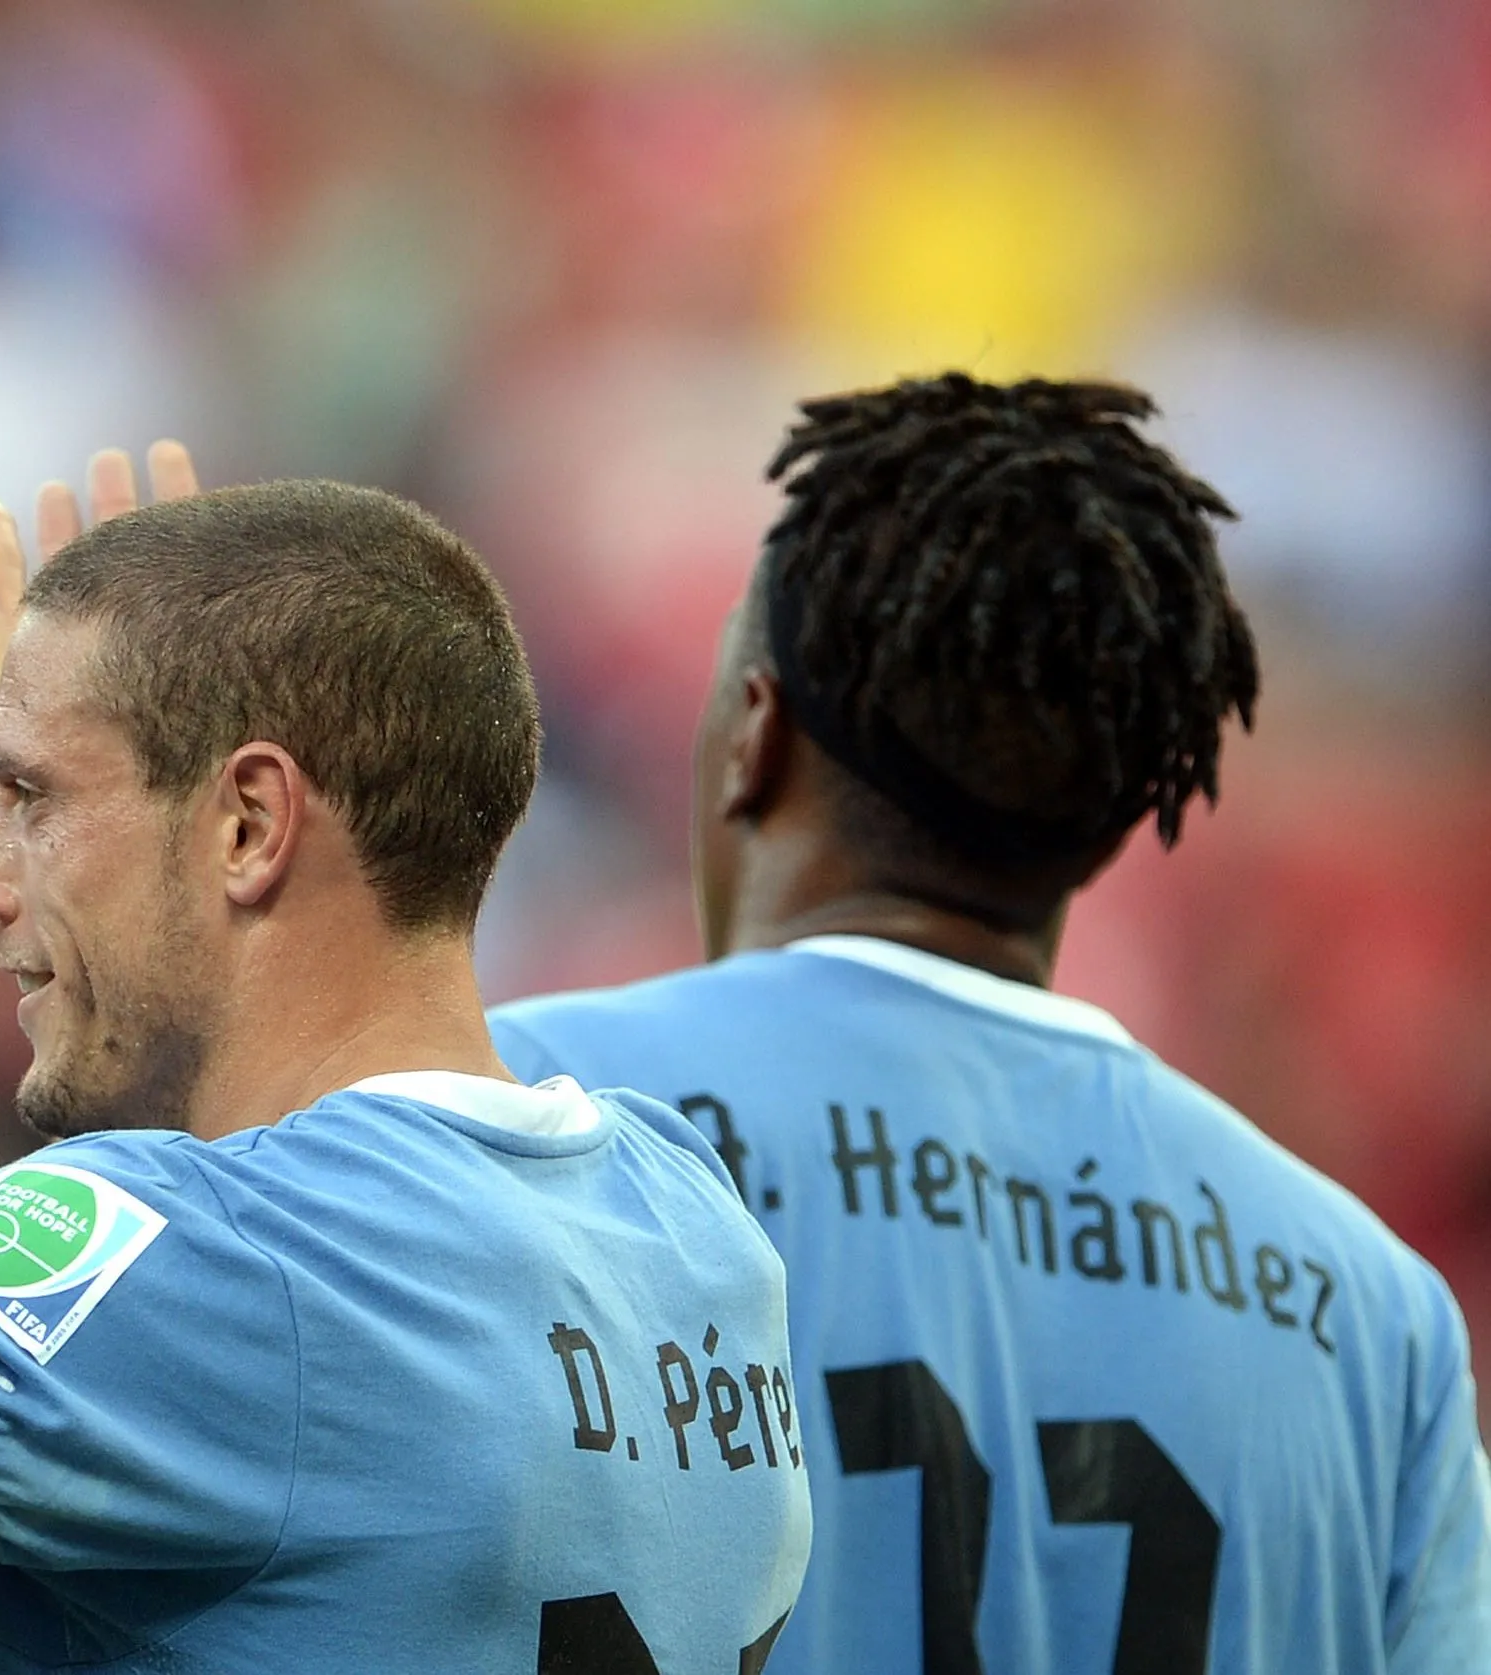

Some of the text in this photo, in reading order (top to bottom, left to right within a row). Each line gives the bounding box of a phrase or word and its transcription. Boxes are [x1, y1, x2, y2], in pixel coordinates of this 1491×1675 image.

[24, 1205, 78, 1243] HOPE
[828, 1103, 1336, 1354] Hernández
[4, 1299, 47, 1342] FIFA
[547, 1322, 801, 1471] D. Pére
